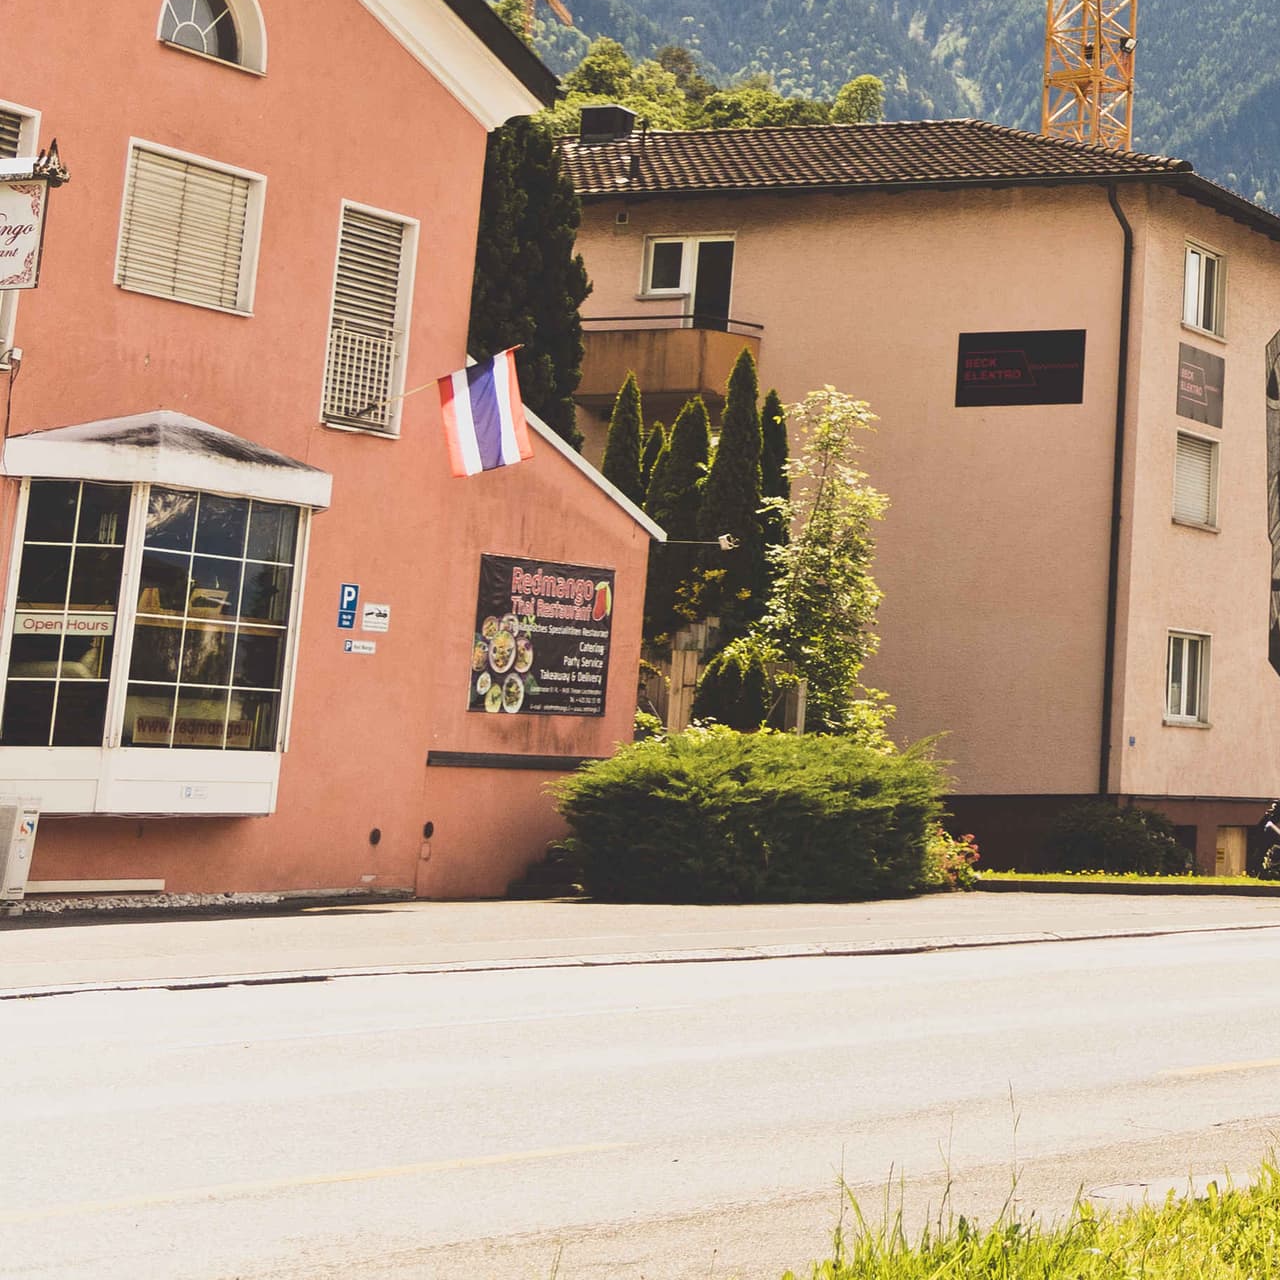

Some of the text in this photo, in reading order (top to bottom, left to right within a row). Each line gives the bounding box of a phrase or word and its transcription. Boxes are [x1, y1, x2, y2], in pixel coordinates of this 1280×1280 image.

[964, 357, 998, 369] BECK
[511, 566, 595, 606] Redmango
[343, 586, 356, 609] P
[511, 595, 593, 622] Thai Restaurant
[23, 618, 109, 632] Open Hours
[579, 641, 605, 656] Catering
[563, 655, 604, 669] Party Service
[540, 669, 571, 683] Takeaway
[577, 672, 602, 685] Delivery
